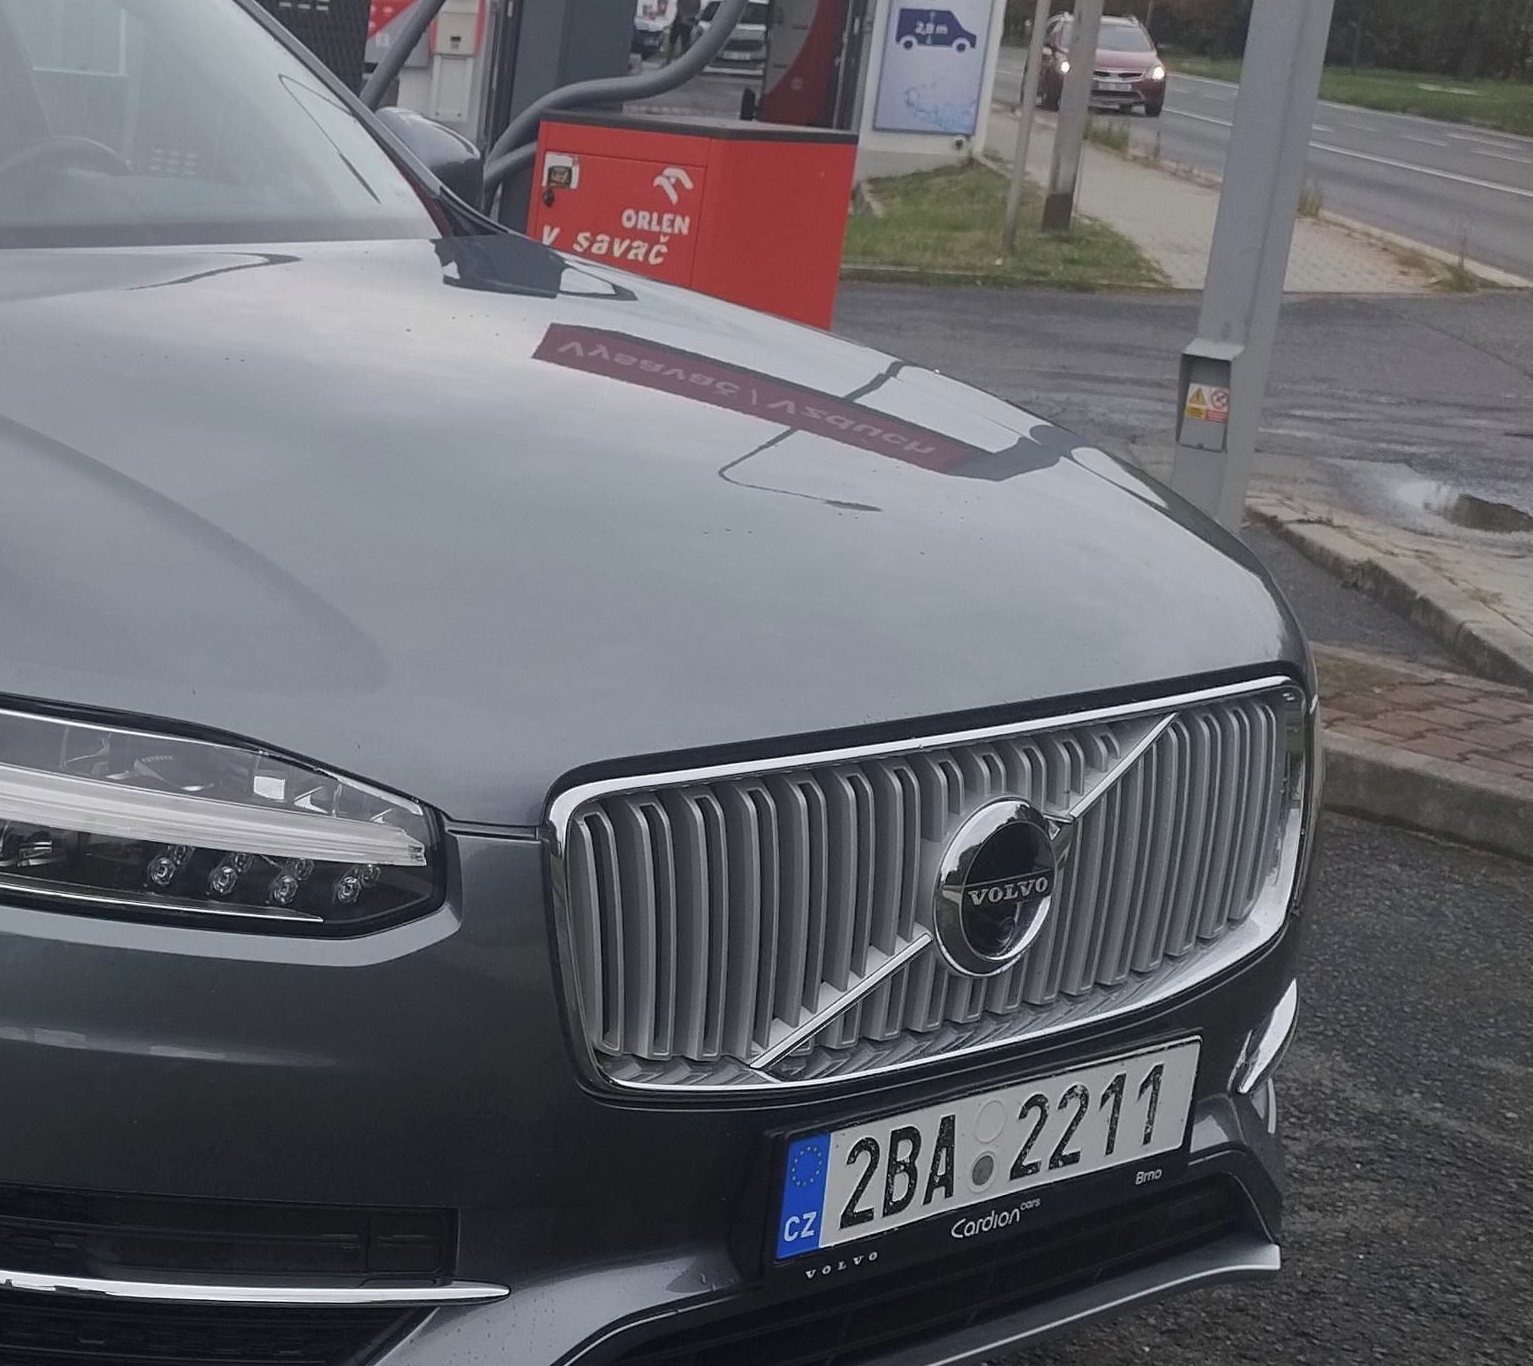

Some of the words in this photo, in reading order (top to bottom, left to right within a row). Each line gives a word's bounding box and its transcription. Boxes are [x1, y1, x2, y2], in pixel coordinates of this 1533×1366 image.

[621, 207, 691, 236] ORLEN
[968, 876, 1049, 906] VOLVO
[838, 1113, 957, 1231] 2BA
[1009, 1062, 1166, 1182] 2211
[1135, 1168, 1164, 1186] Brno
[783, 1210, 818, 1243] CZ
[951, 1207, 1021, 1240] Cardion
[1019, 1197, 1042, 1212] cars
[805, 1250, 879, 1280] VOLVO
